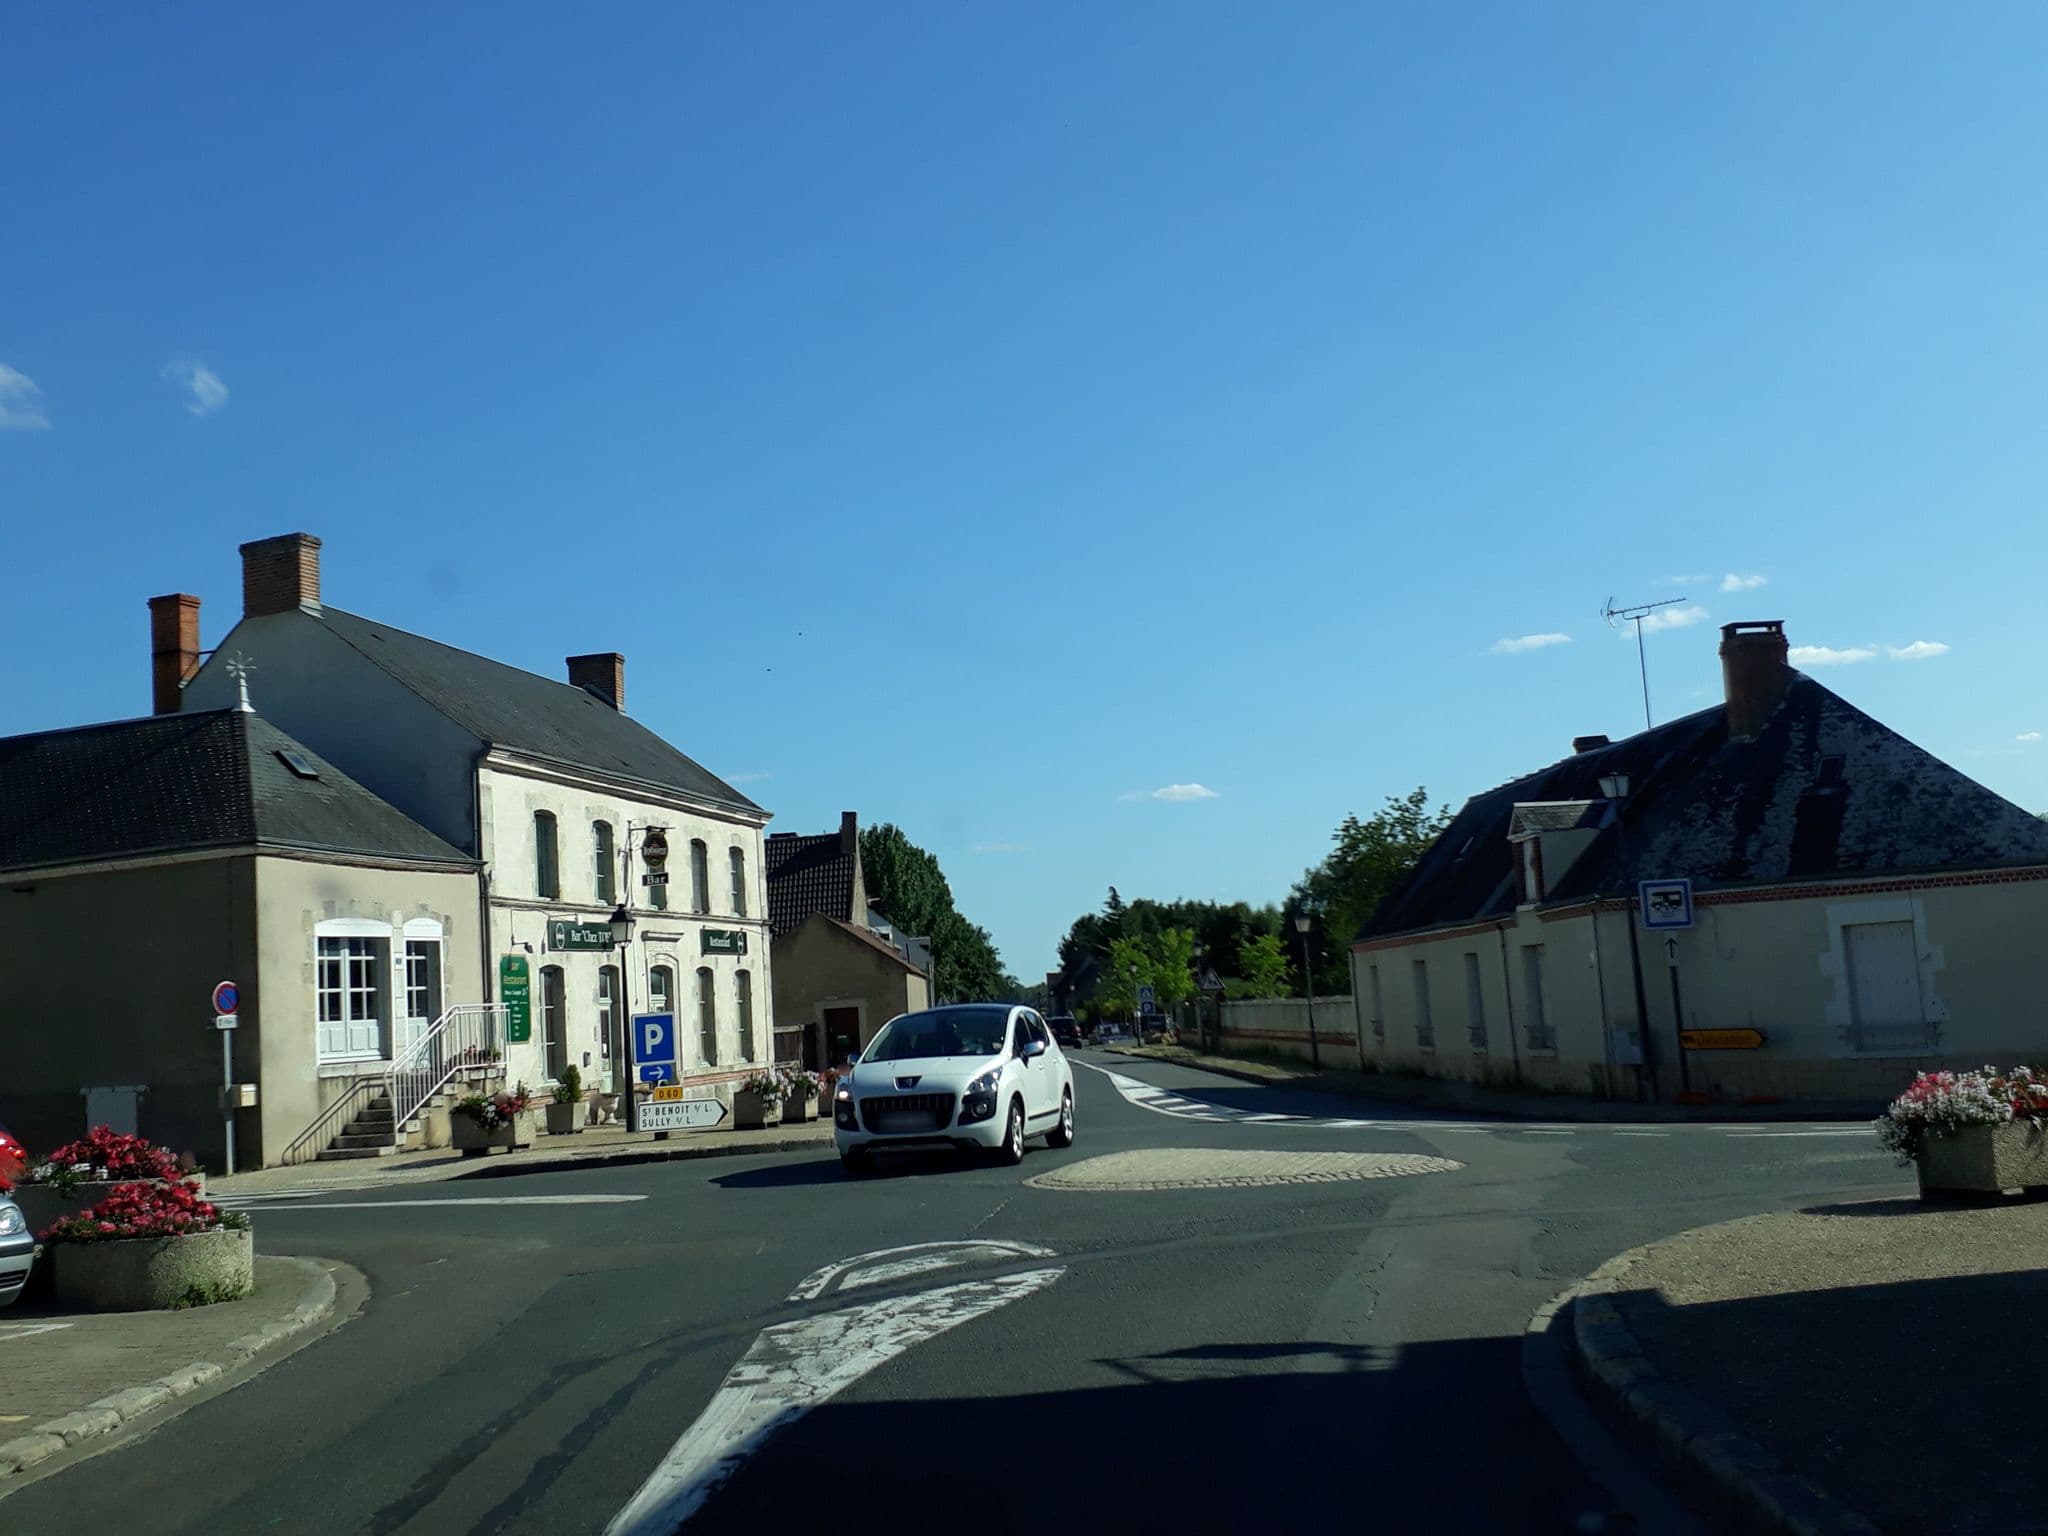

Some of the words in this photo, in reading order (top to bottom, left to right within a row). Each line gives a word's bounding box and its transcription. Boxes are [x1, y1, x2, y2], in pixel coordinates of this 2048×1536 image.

[647, 876, 666, 885] Bar
[645, 1023, 663, 1054] P
[659, 1090, 665, 1099] D
[666, 1089, 679, 1098] 60
[655, 1105, 690, 1116] BENOIT
[642, 1116, 671, 1128] SULLY
